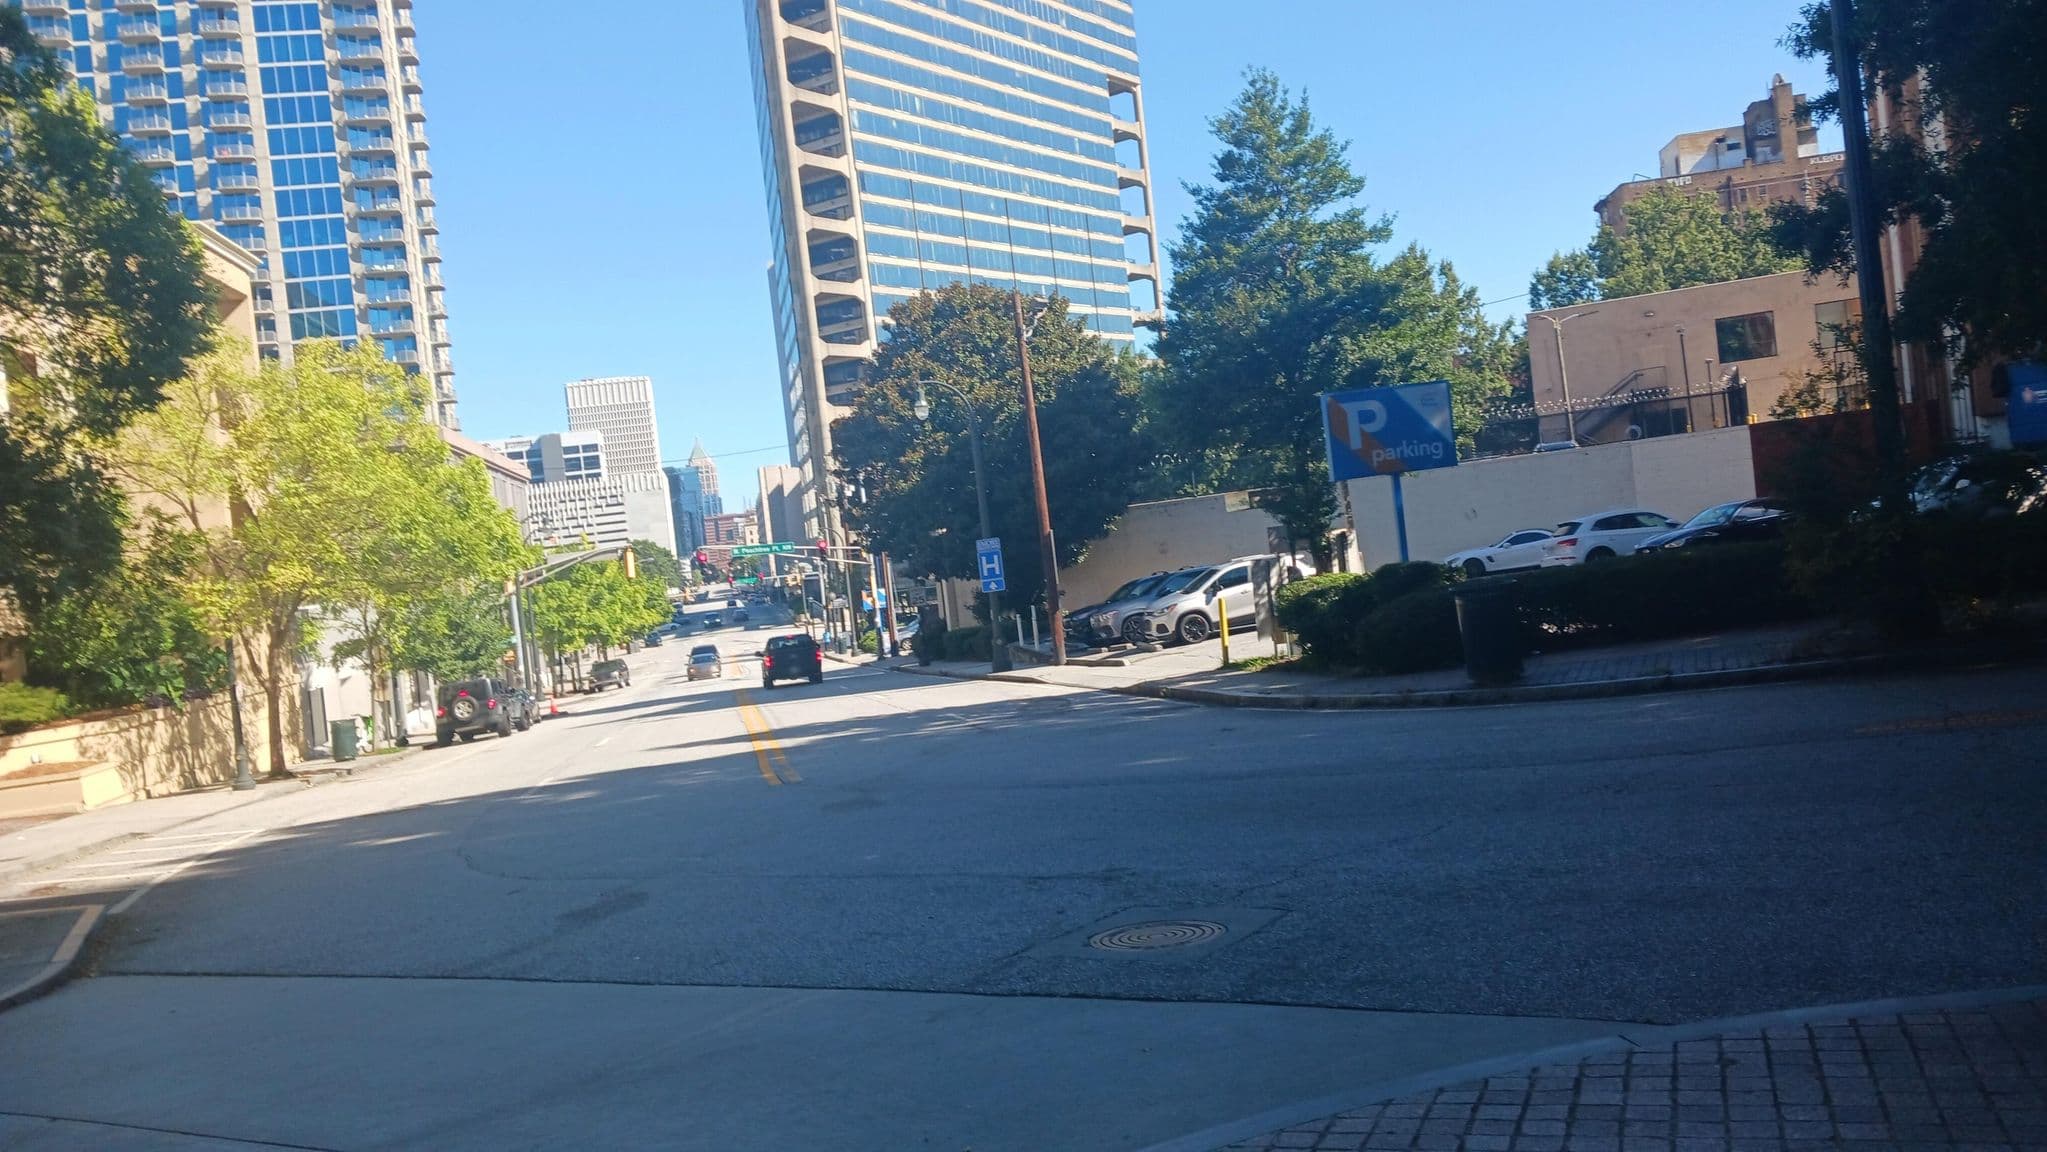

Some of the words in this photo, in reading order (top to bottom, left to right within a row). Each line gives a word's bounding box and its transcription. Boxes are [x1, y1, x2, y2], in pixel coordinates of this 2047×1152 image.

[1339, 400, 1387, 449] P
[1372, 441, 1443, 467] parking
[981, 555, 1000, 576] H
